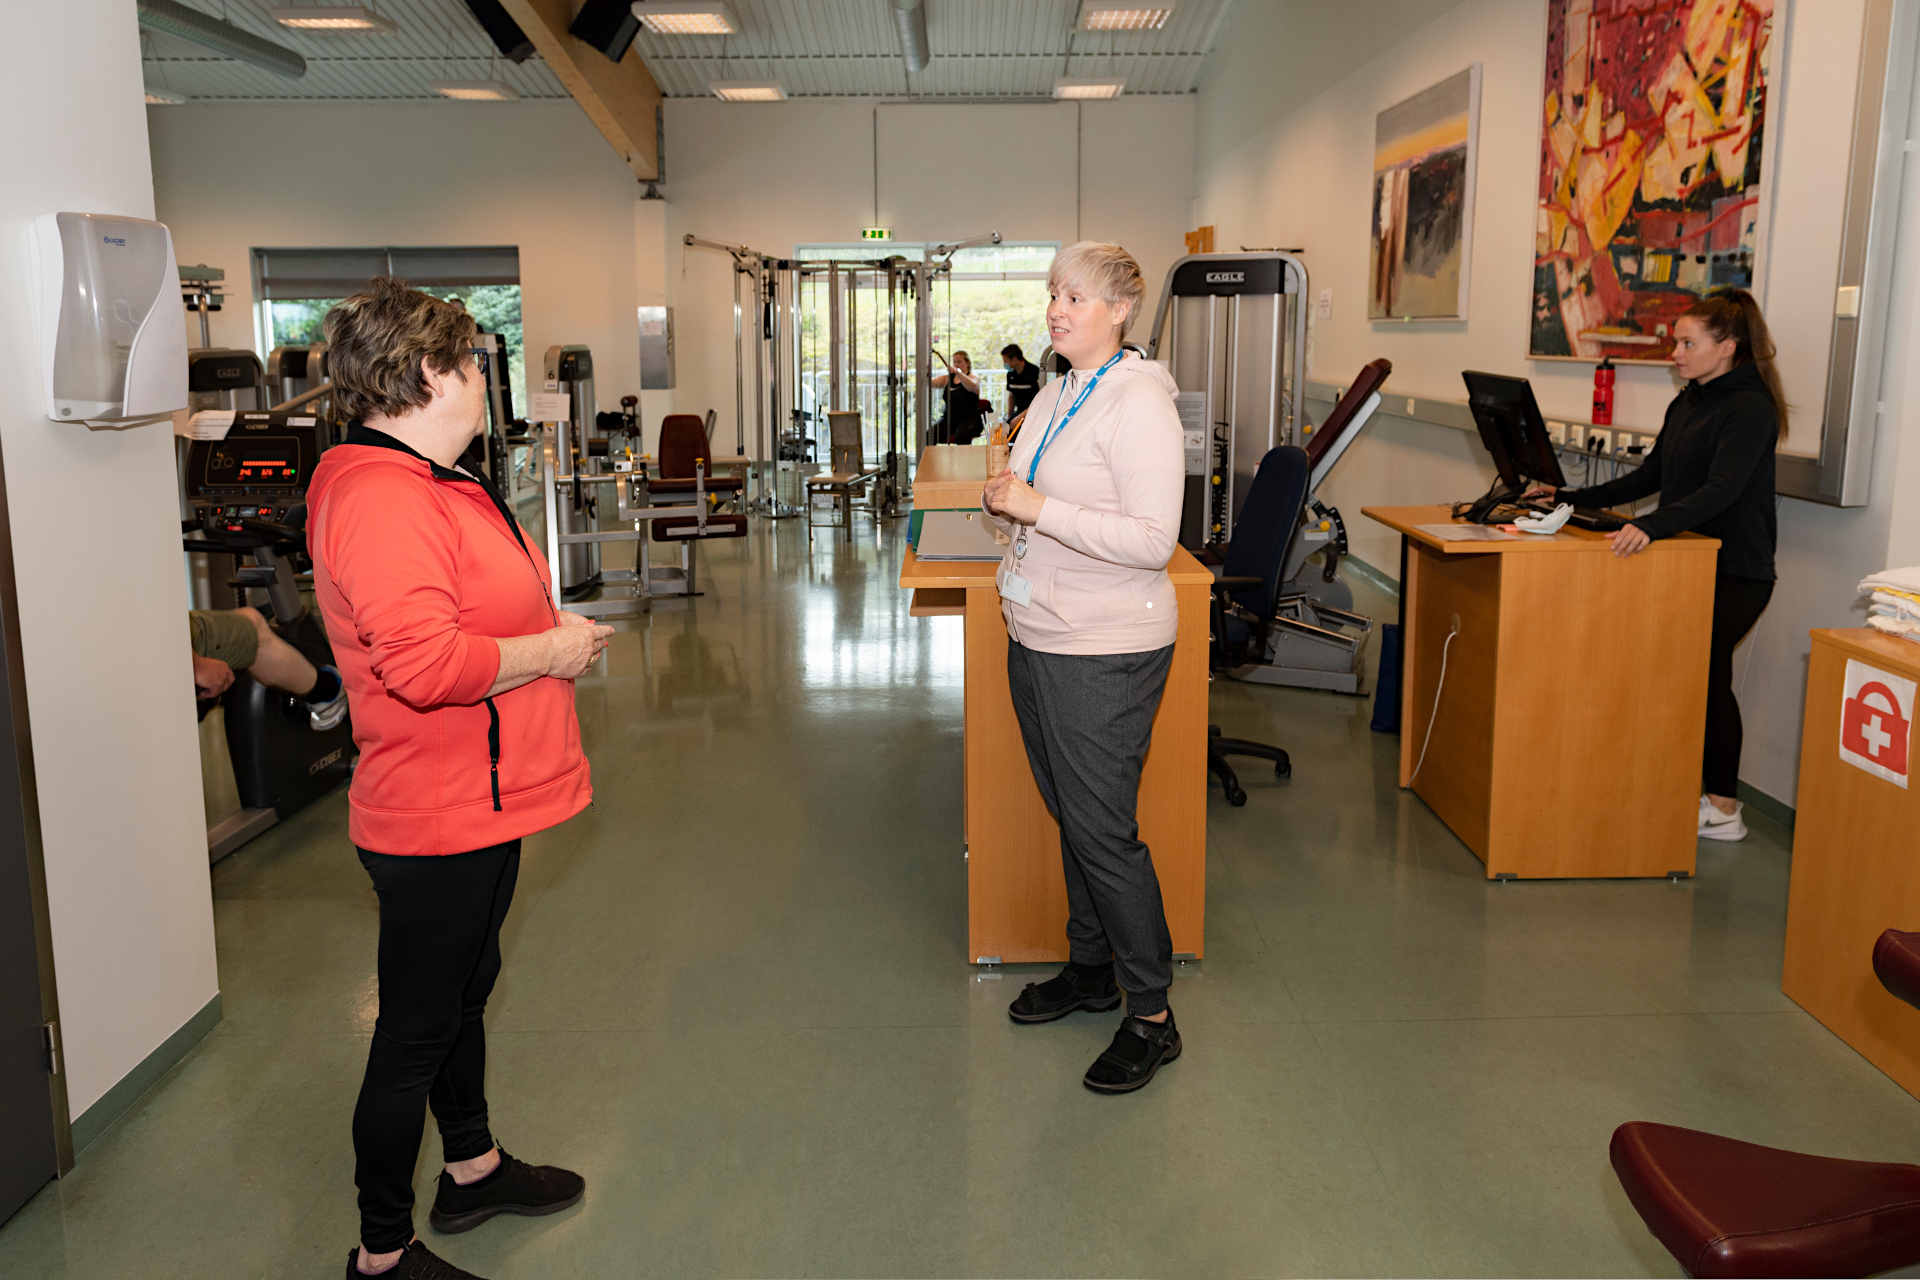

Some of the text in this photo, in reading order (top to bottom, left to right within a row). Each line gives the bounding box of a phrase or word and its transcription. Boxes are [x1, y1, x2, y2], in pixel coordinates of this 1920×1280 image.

[1205, 271, 1245, 283] EAGLE
[1149, 338, 1156, 347] 4
[1040, 363, 1046, 371] 5
[548, 370, 555, 380] 6
[320, 747, 343, 770] CYBEX
